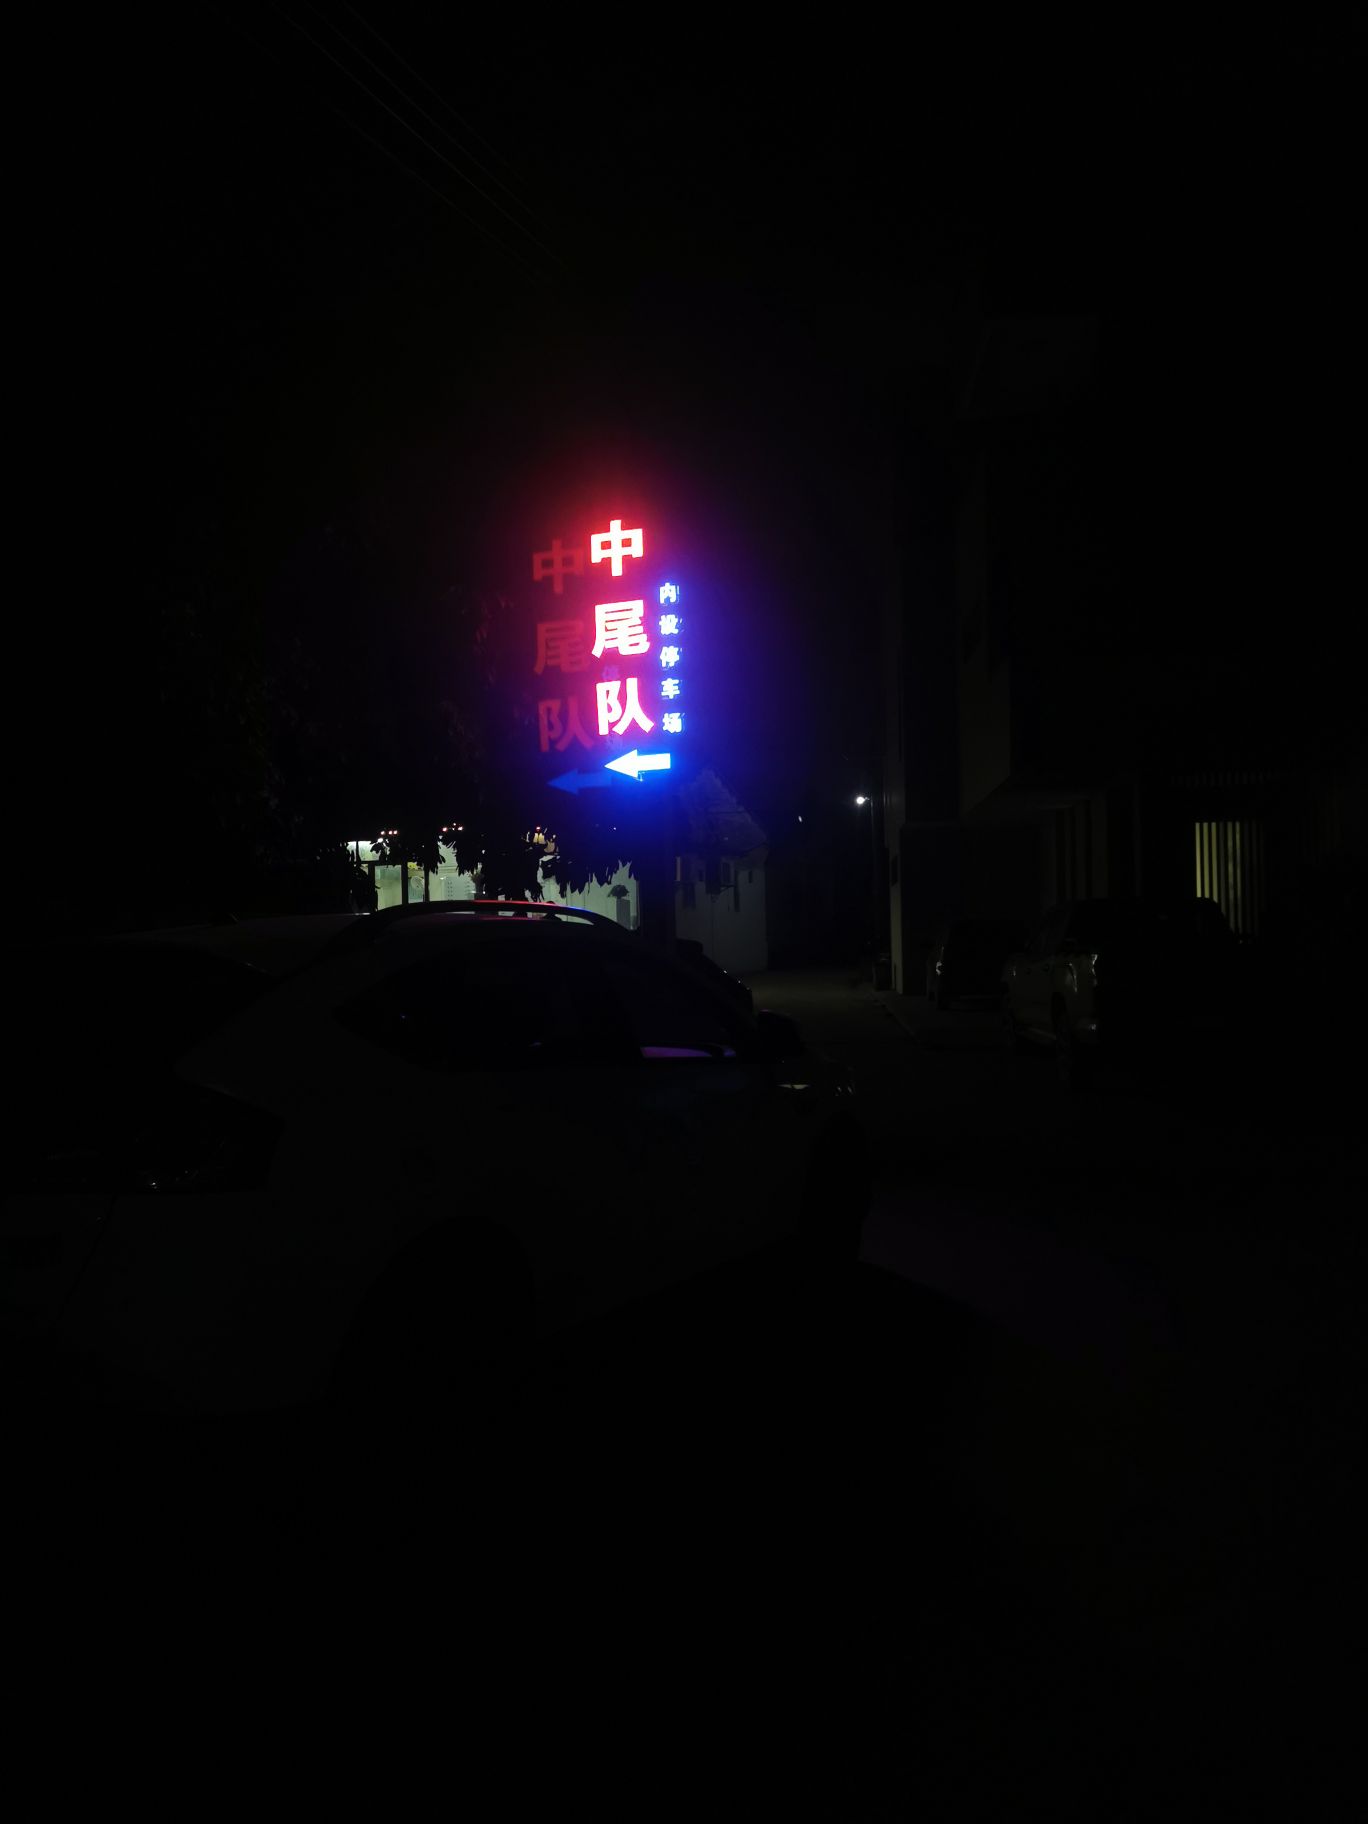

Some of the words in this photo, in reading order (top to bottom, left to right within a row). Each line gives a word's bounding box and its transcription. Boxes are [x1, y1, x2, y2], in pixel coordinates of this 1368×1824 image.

[590, 519, 655, 736] 中尾队
[659, 581, 683, 734] 内设停车场
